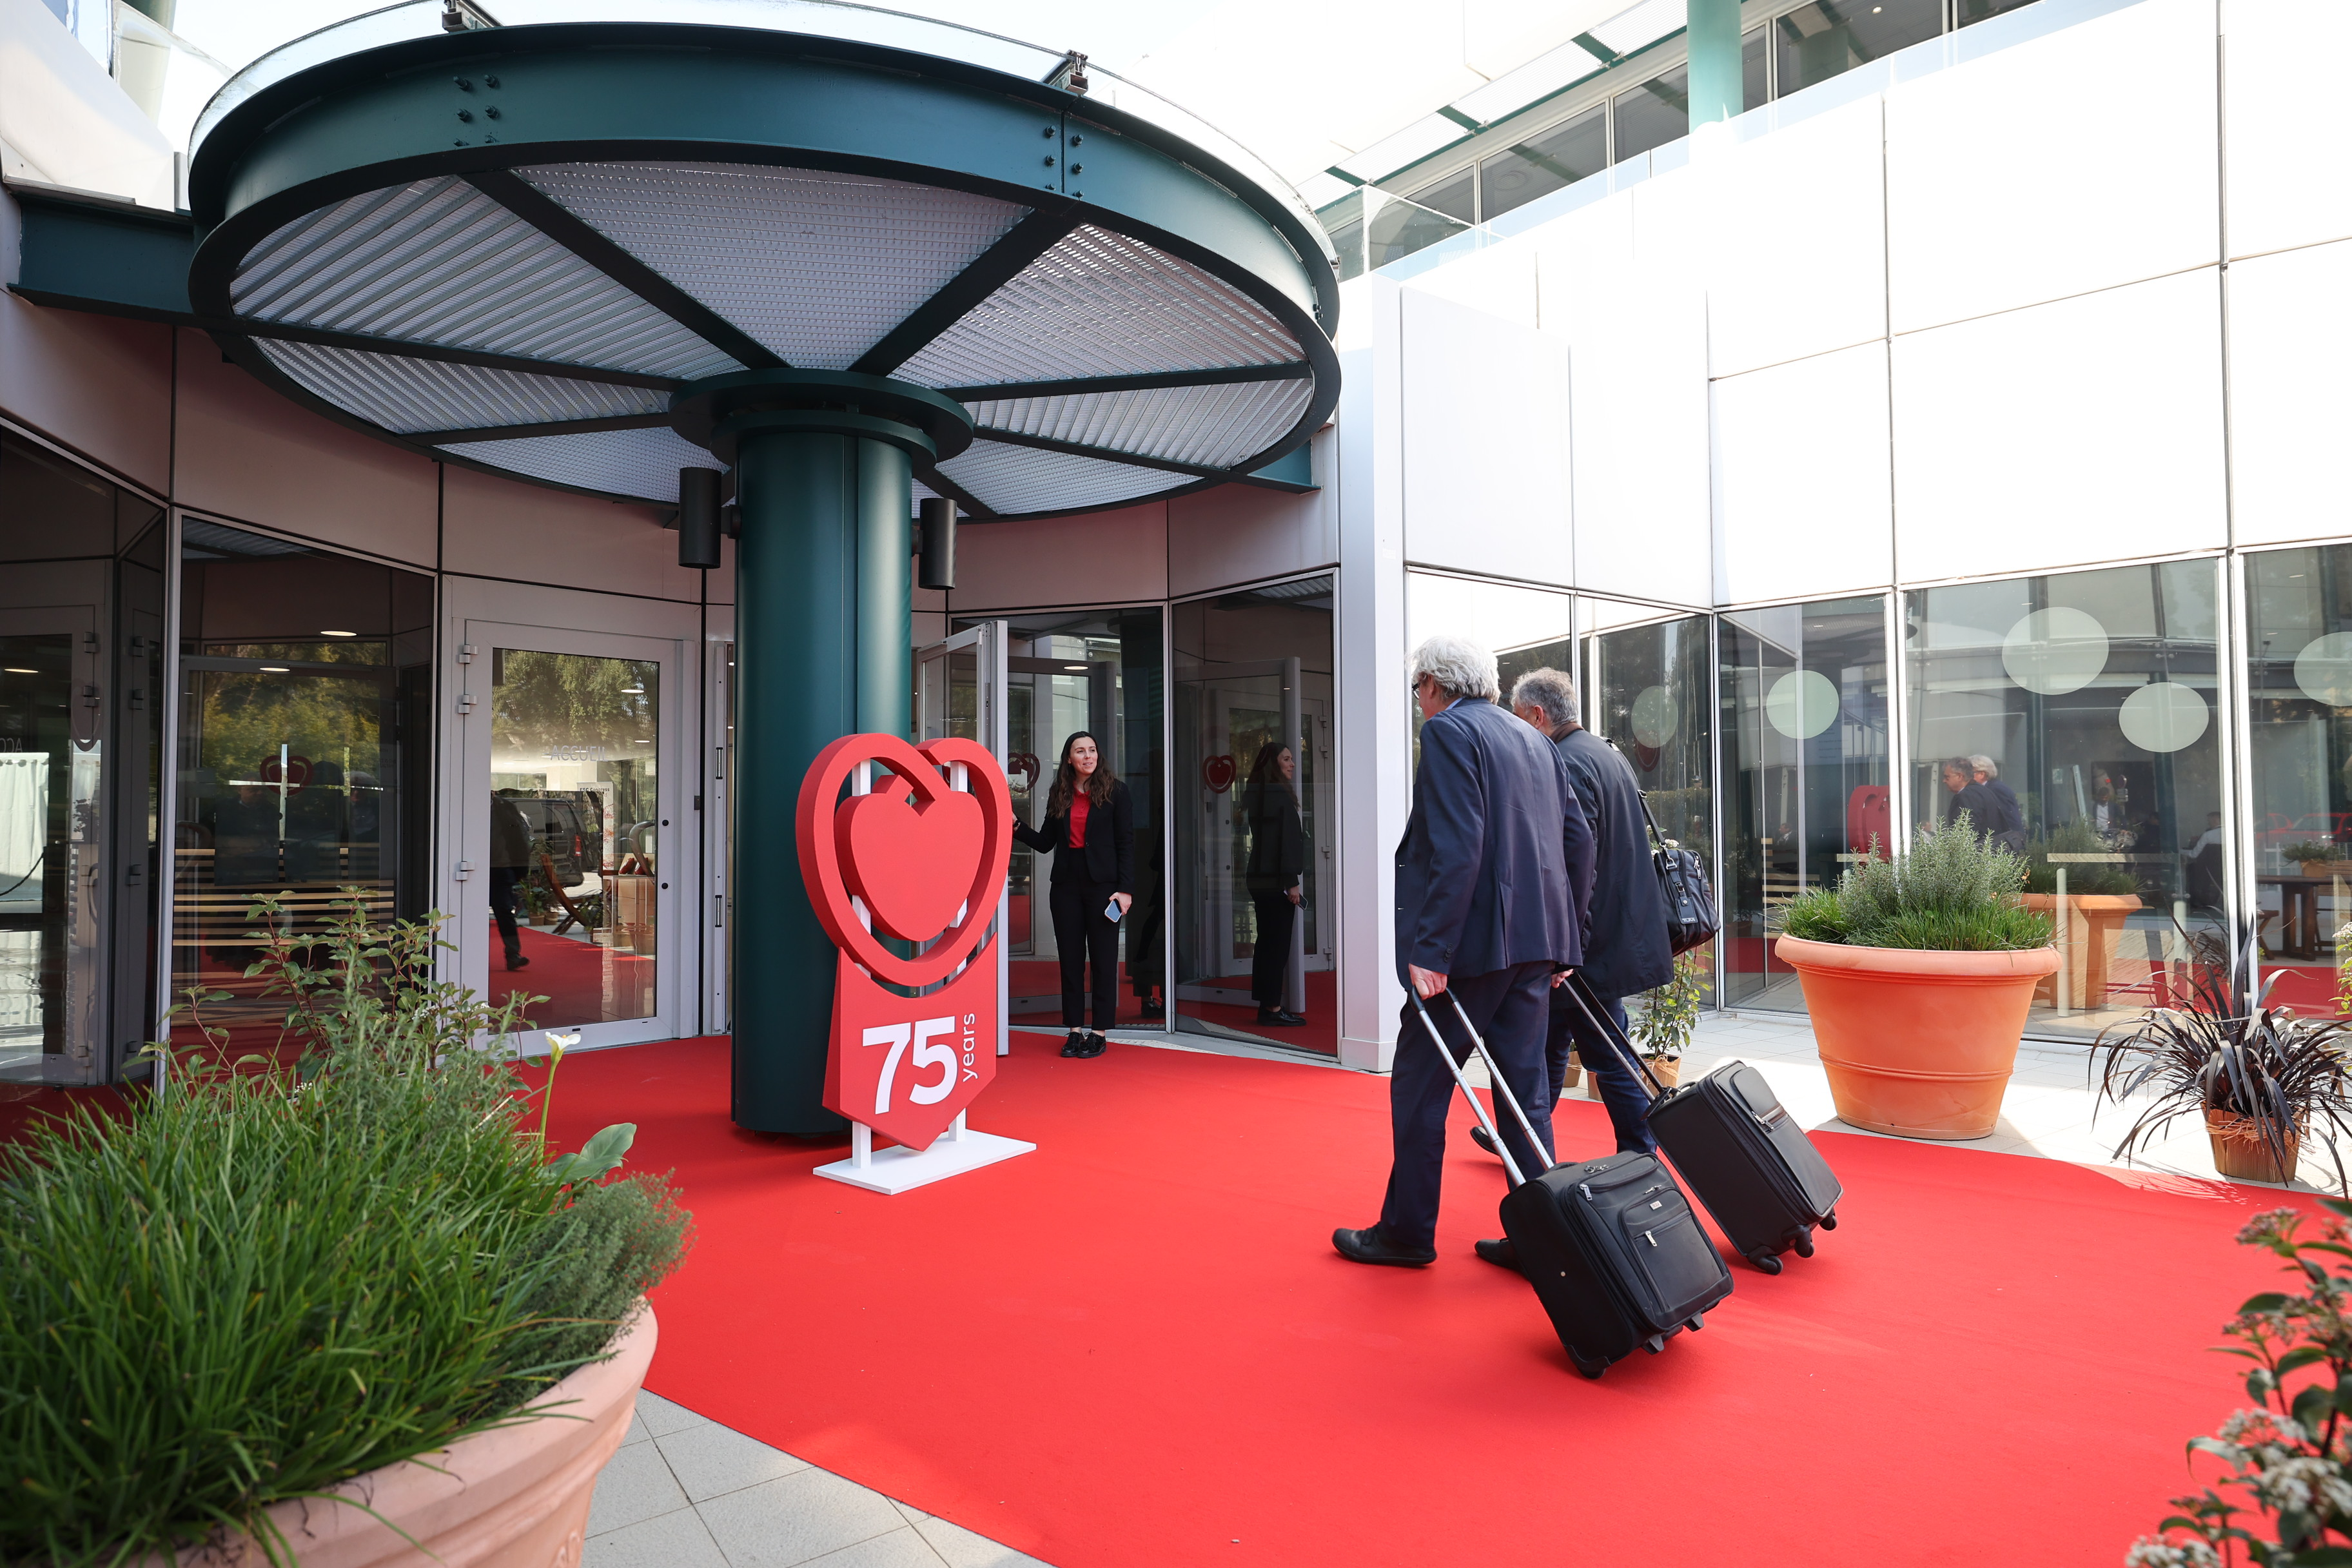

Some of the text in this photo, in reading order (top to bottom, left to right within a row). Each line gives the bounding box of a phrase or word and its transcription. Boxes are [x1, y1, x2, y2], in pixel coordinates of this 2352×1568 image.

[550, 745, 609, 762] ACCUEIL
[862, 1015, 958, 1115] 75
[963, 1013, 979, 1083] years
